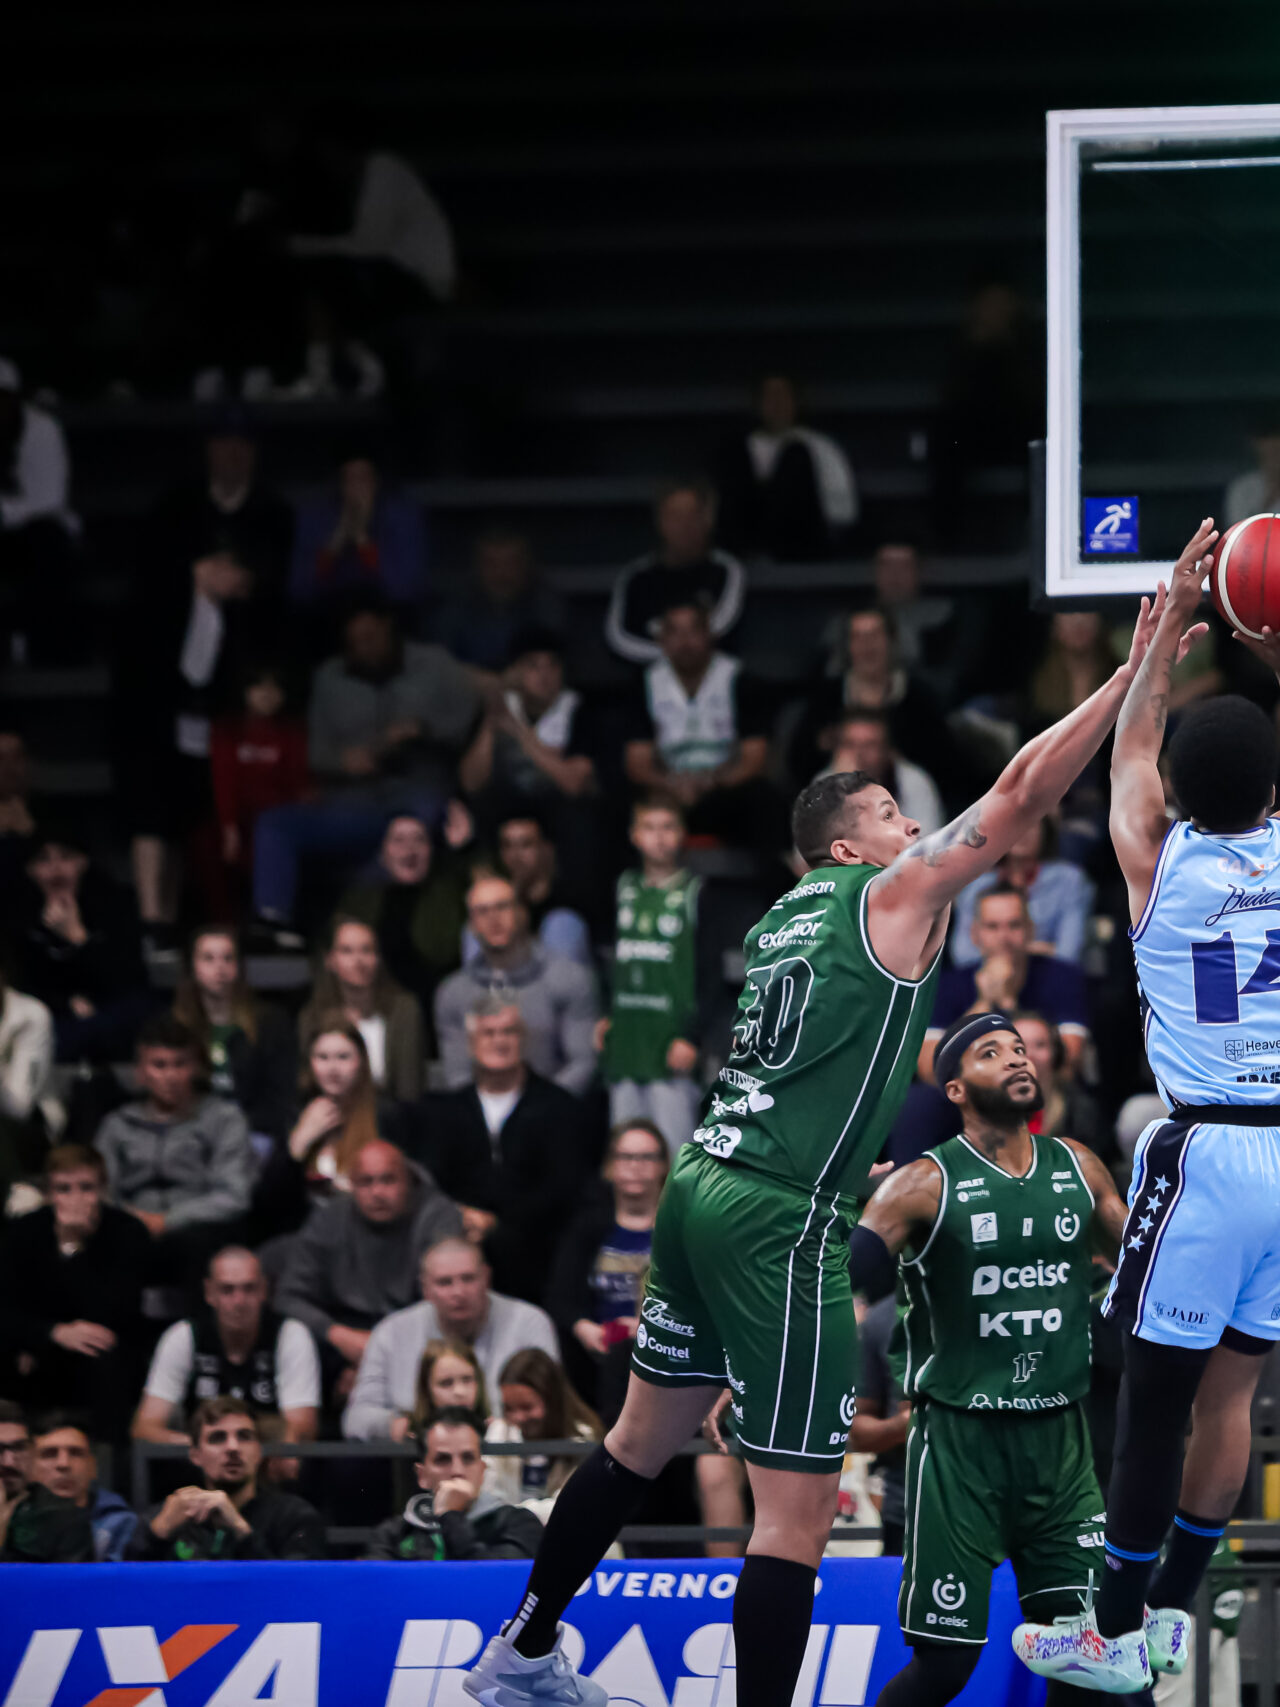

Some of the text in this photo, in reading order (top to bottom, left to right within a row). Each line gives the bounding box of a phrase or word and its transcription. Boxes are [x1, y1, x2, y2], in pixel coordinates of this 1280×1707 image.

[1002, 1259, 1071, 1289] ceisc
[979, 1308, 1062, 1337] KTO
[1167, 1307, 1210, 1325] JADE
[647, 1337, 690, 1359] Contel
[574, 1571, 738, 1600] VERNO
[938, 1616, 969, 1628] ceisc
